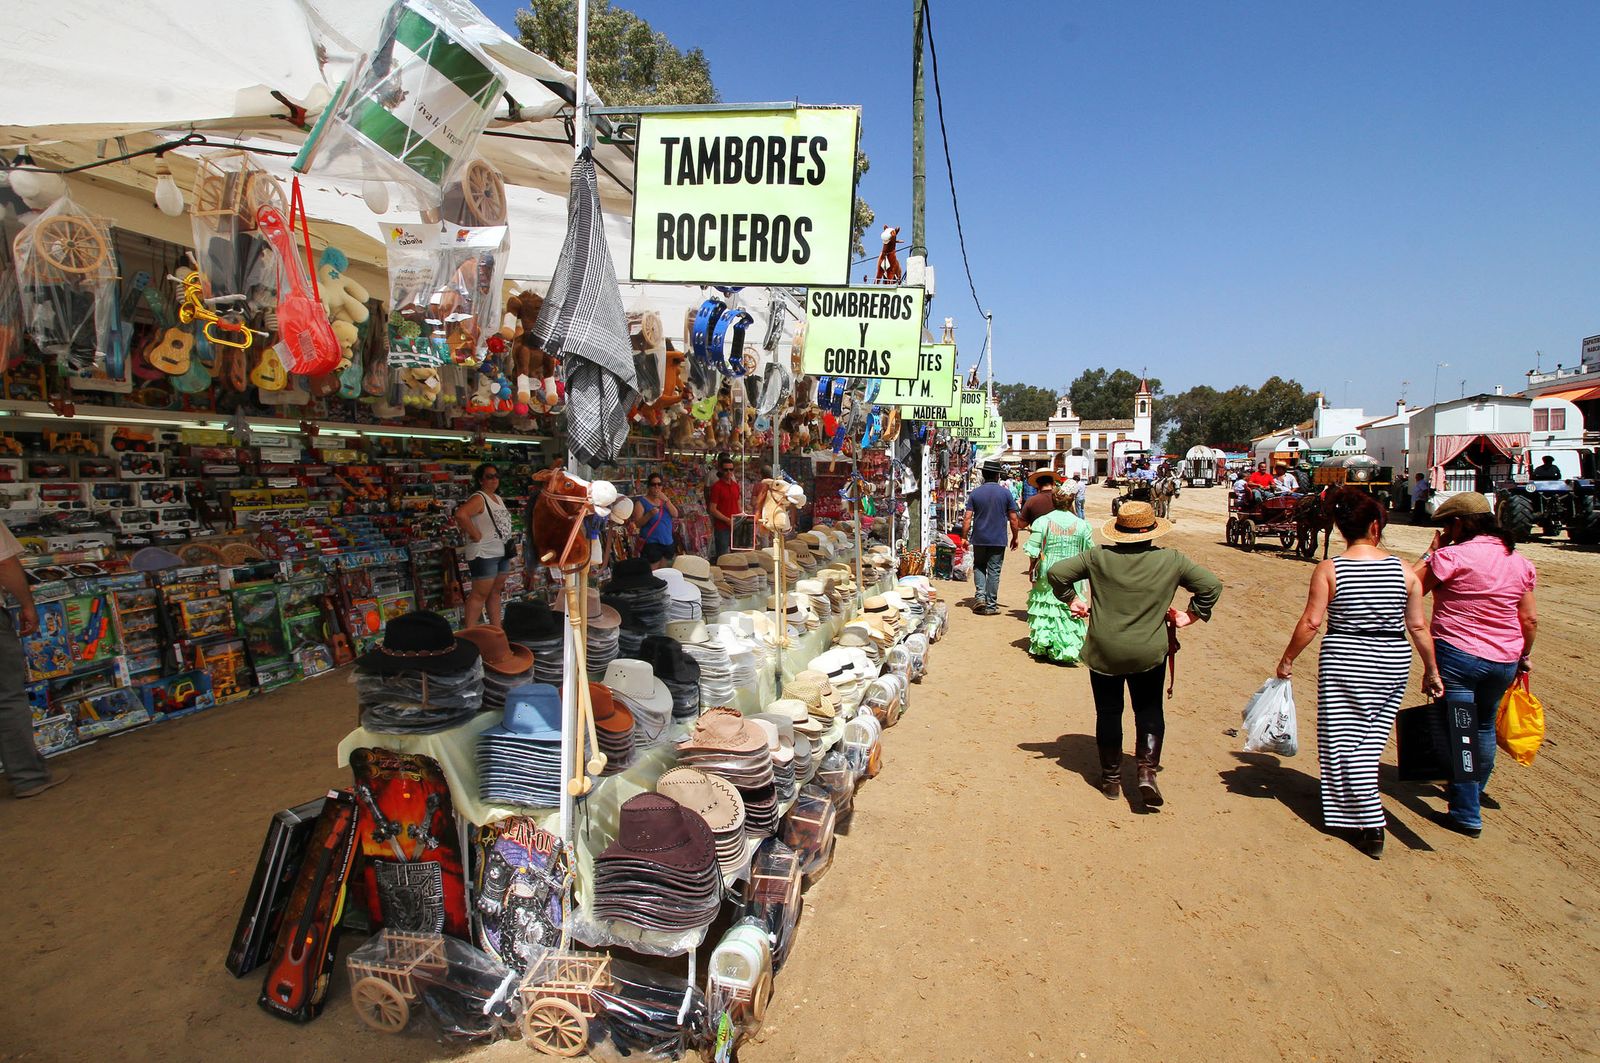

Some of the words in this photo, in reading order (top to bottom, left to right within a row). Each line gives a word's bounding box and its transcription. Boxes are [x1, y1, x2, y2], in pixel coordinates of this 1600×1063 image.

[660, 135, 828, 186] TAMBORES
[656, 212, 813, 265] ROCIEROS
[811, 291, 912, 322] SOMBREROS
[859, 322, 867, 348] Y
[824, 348, 891, 376] GORRAS
[913, 406, 947, 420] MADERA
